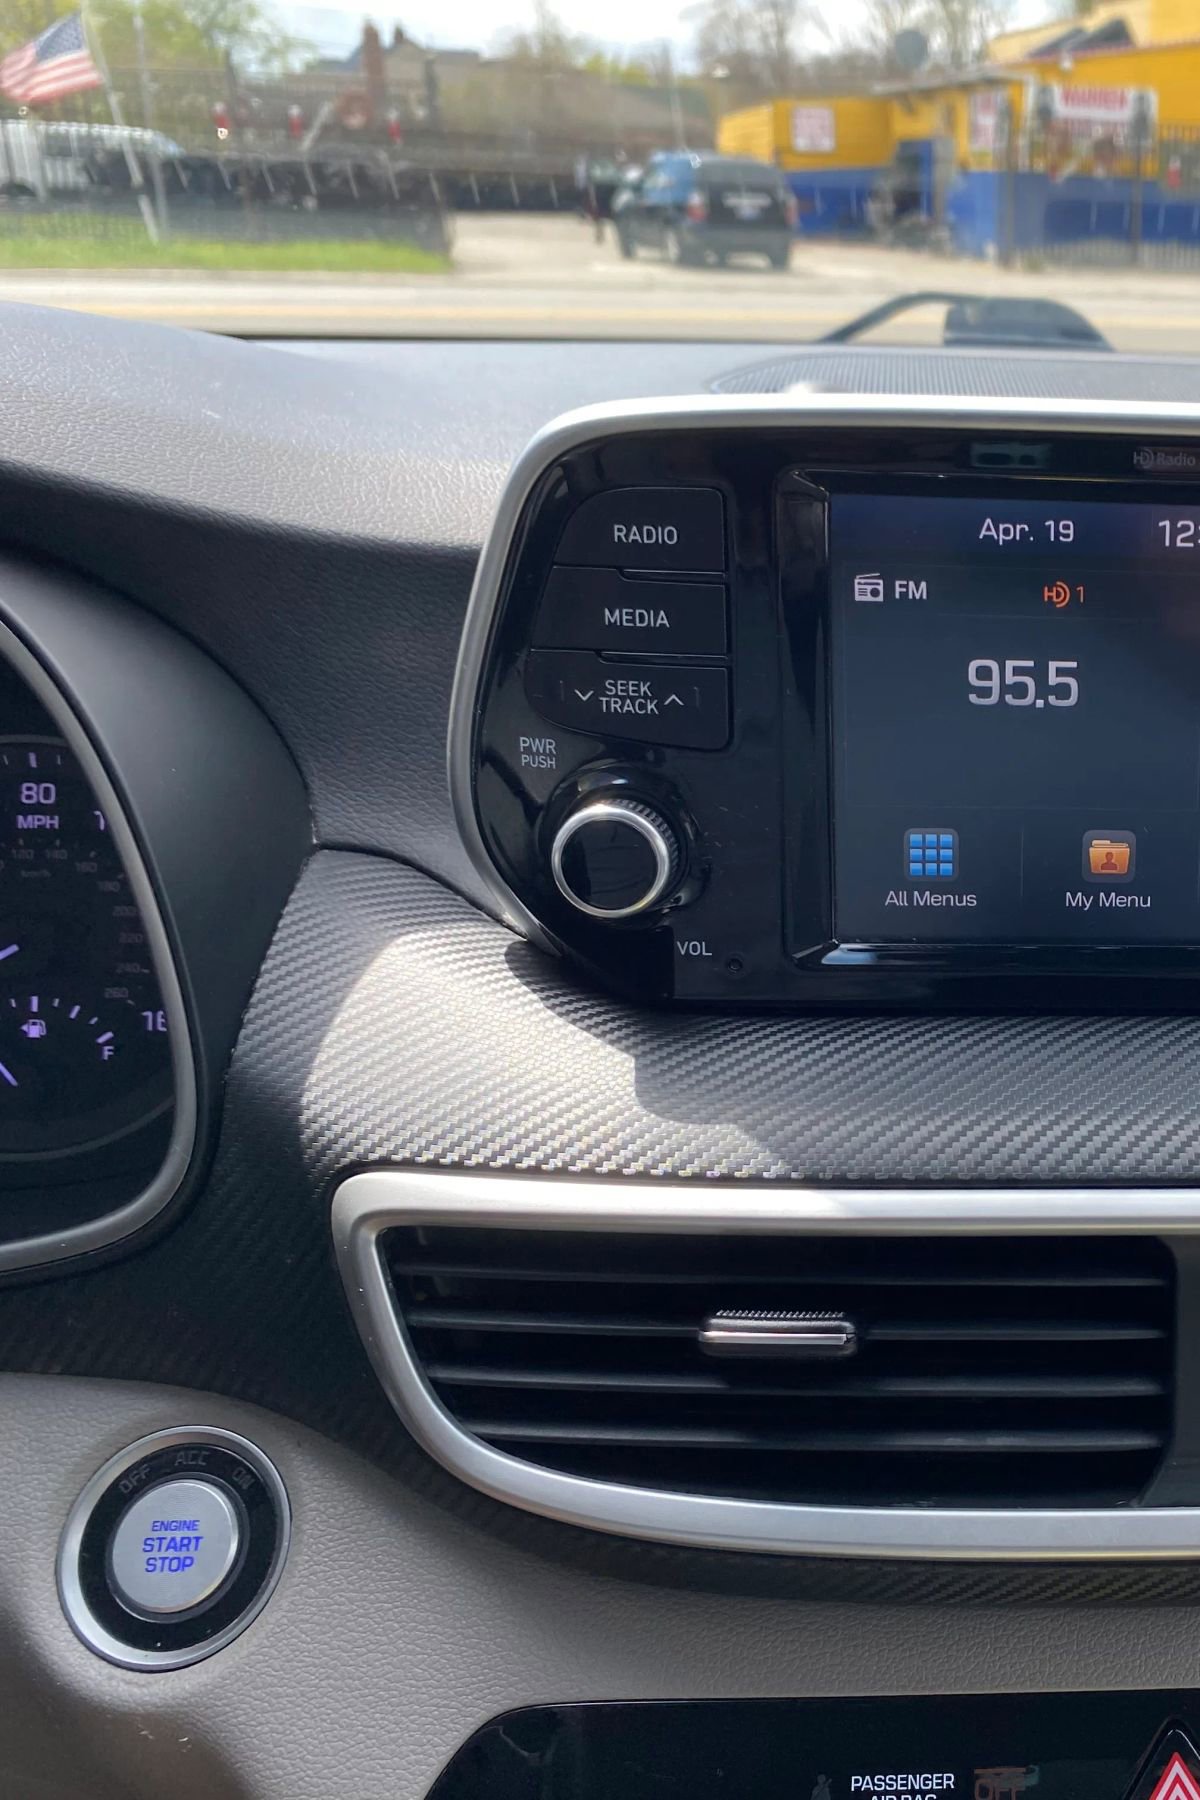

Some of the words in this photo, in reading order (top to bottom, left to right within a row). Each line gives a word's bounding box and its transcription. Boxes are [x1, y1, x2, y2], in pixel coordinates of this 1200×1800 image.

[1157, 452, 1196, 467] Radio
[613, 524, 678, 545] RADIO
[978, 517, 1034, 546] Apr.
[1044, 519, 1074, 542] 19
[894, 580, 927, 600] FM
[604, 607, 670, 628] MEDIA
[604, 680, 652, 698] SEEK
[967, 659, 1079, 709] 95.5
[599, 696, 659, 715] TRACK
[519, 736, 557, 755] PWR
[521, 753, 557, 770] PUSH
[20, 782, 57, 805] 80
[16, 814, 60, 830] MPH
[884, 890, 910, 907] All
[913, 891, 977, 908] Menus
[1065, 891, 1095, 911] My
[1099, 891, 1151, 908] Menu
[676, 940, 713, 956] VOL
[102, 1045, 115, 1061] F
[174, 1450, 210, 1467] ACC
[118, 1464, 152, 1495] OFF
[231, 1467, 255, 1491] ON
[151, 1519, 201, 1533] ENGINE
[142, 1535, 204, 1553] START
[144, 1556, 195, 1574] STOP
[851, 1773, 955, 1792] PASSENGER
